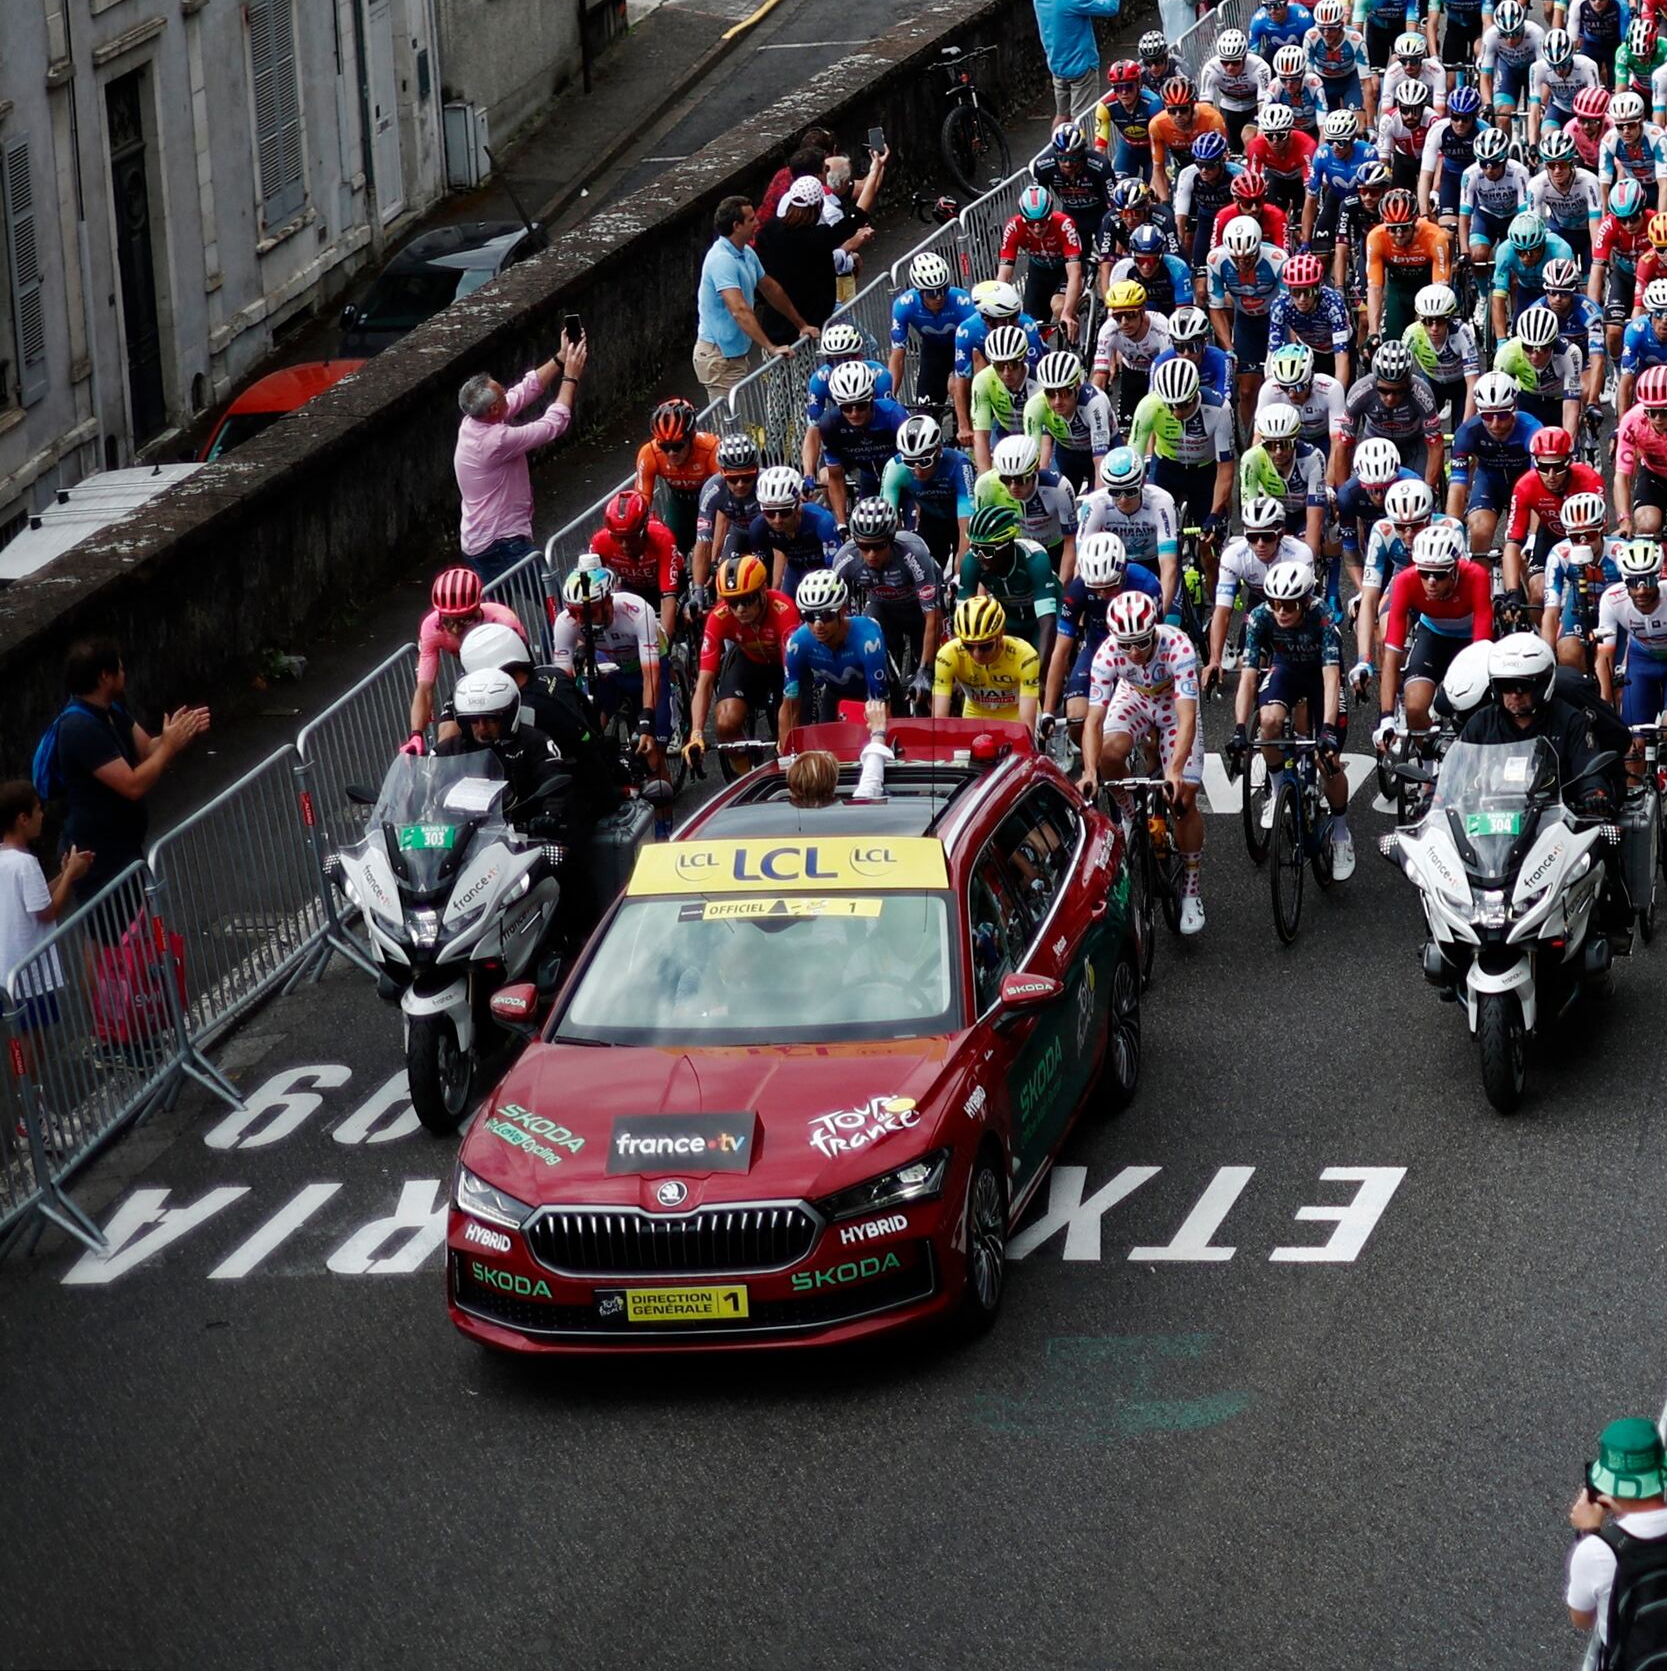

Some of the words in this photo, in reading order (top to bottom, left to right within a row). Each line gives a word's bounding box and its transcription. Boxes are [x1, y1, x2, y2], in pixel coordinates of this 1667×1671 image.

[1339, 211, 1350, 234] BOSS
[1101, 231, 1111, 254] BOSS
[1489, 818, 1512, 835] 304
[423, 832, 445, 847] 303
[680, 852, 719, 867] LCL
[732, 846, 838, 881] LCL
[855, 848, 897, 863] LCL
[709, 903, 765, 915] OFFICIEL
[848, 901, 857, 914] 1
[963, 1085, 987, 1119] HYBRID
[464, 1224, 512, 1253] HYBRID
[840, 1214, 908, 1245] HYBRID
[631, 1292, 713, 1306] DIRECTION
[722, 1291, 741, 1313] 1
